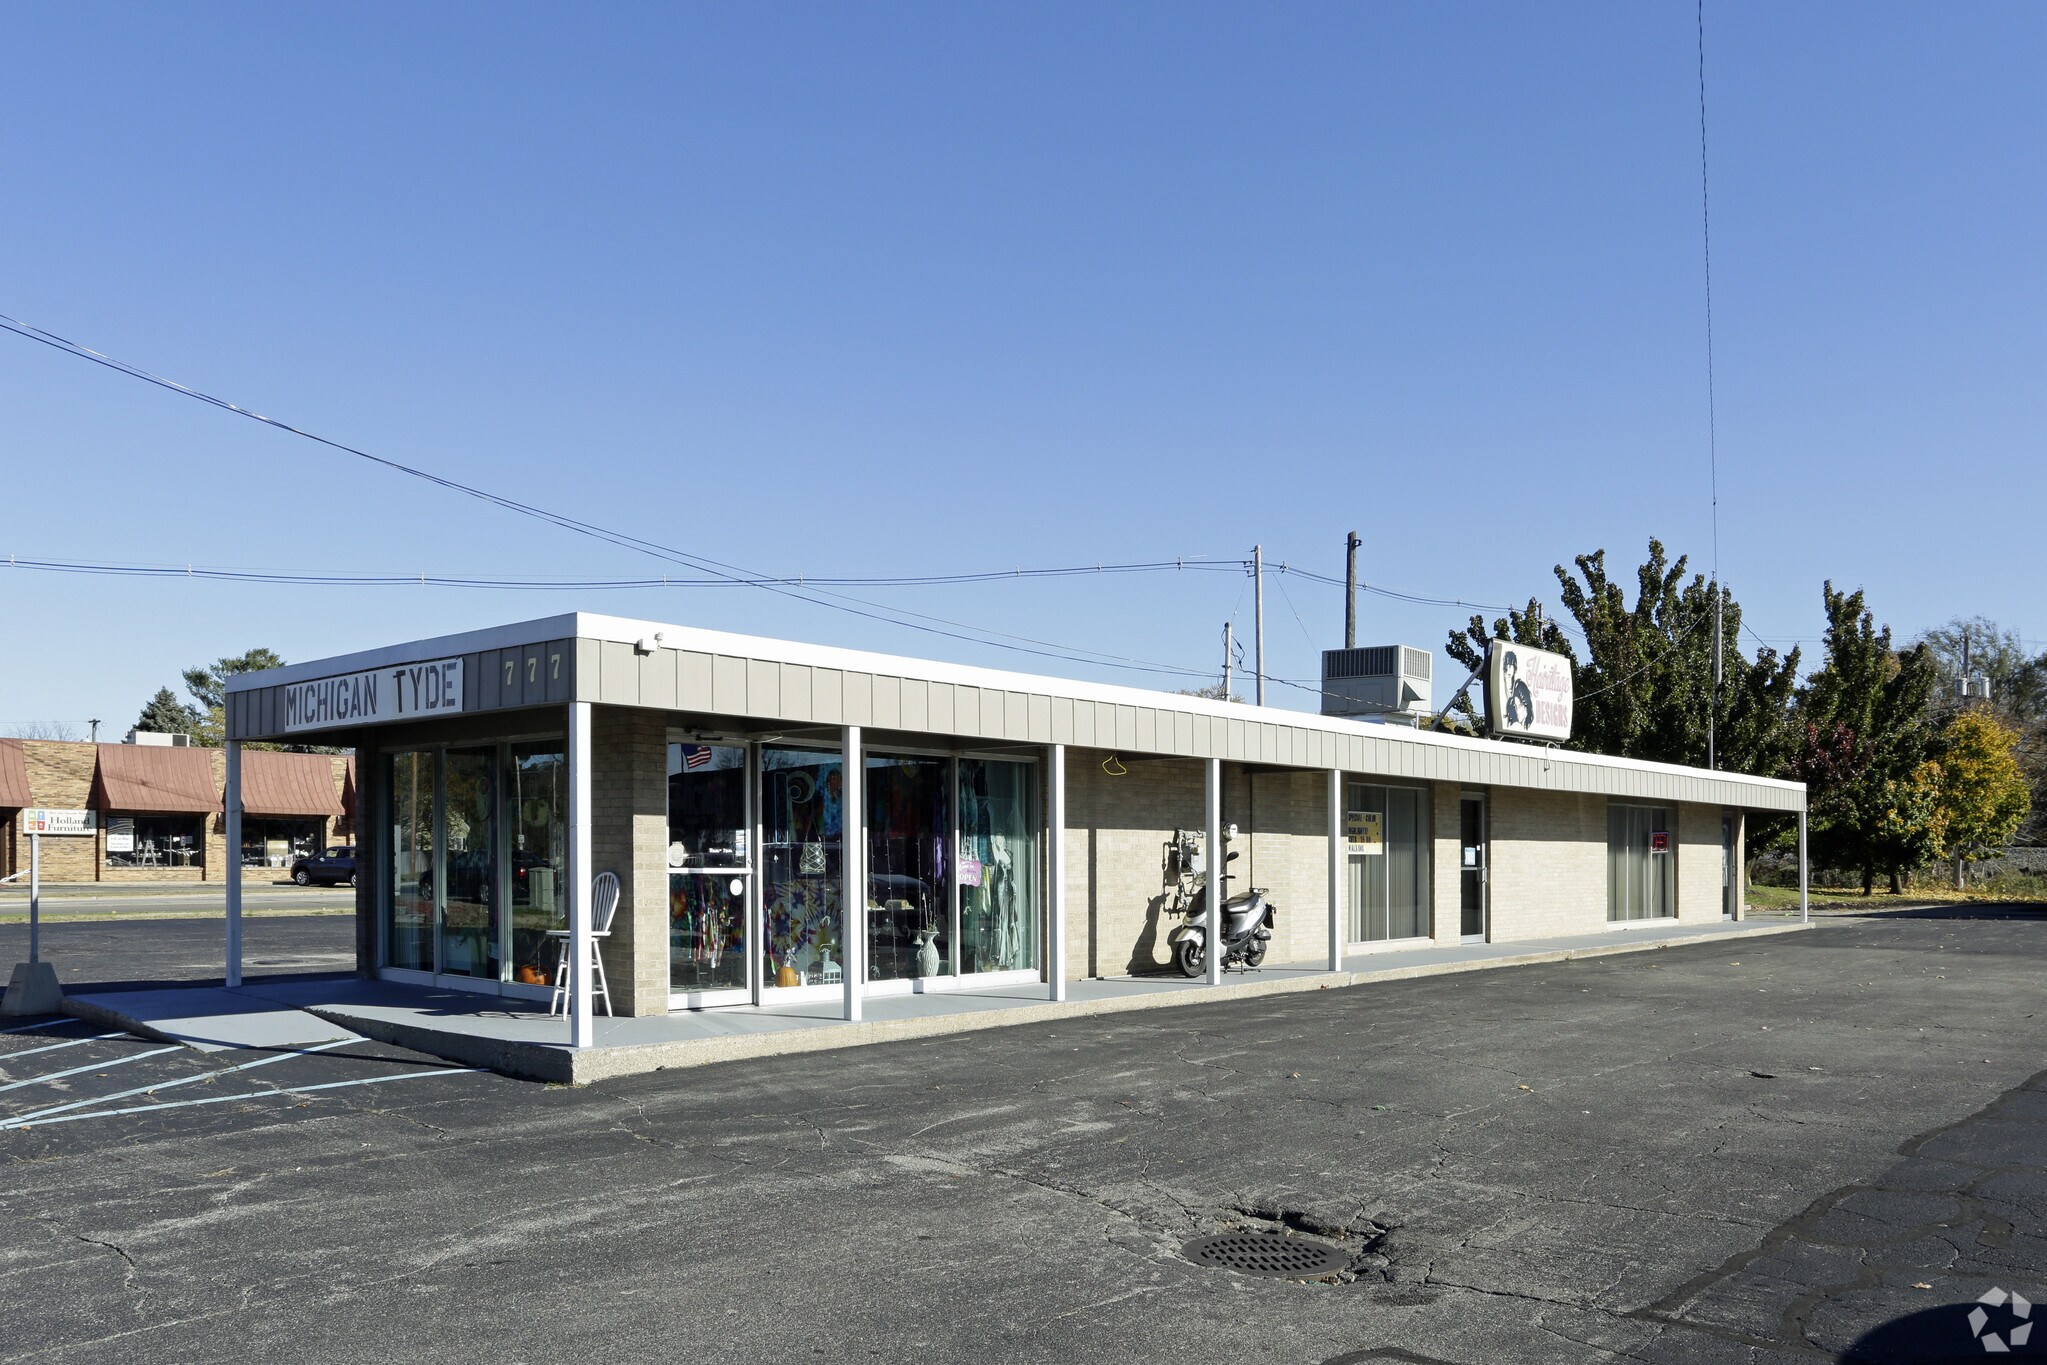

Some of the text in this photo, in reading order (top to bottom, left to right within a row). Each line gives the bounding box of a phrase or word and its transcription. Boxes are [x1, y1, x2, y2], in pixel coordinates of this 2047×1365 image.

[505, 654, 561, 687] 777
[286, 661, 458, 727] MICHIGAN TYDE
[1535, 700, 1568, 728] DESIGNS
[48, 823, 93, 832] Furniture
[50, 816, 91, 825] Holland
[959, 873, 977, 882] OPEN
